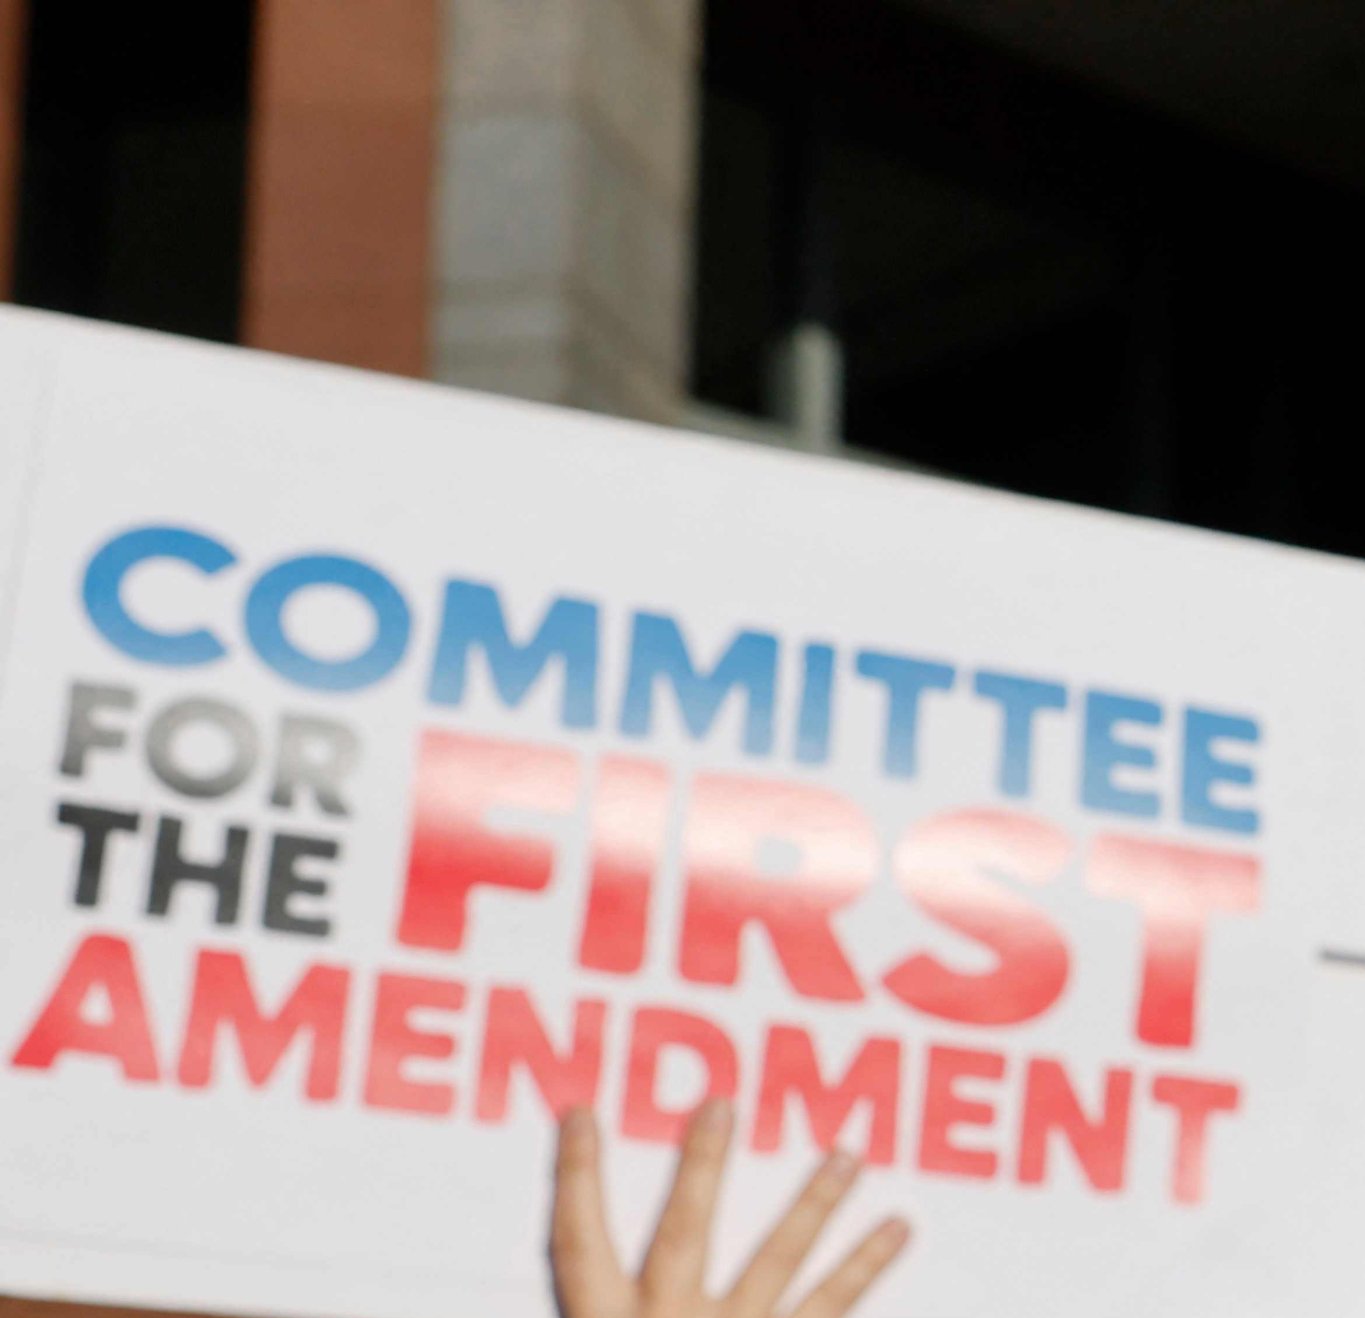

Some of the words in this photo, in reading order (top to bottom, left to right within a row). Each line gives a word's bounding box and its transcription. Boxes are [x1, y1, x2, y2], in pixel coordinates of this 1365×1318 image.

[56, 680, 364, 820] FOR
[80, 523, 1262, 836] COMMITTEE
[52, 797, 343, 941] THE
[393, 727, 1263, 1053] FIRST
[8, 930, 1245, 1207] AMENDMENT
